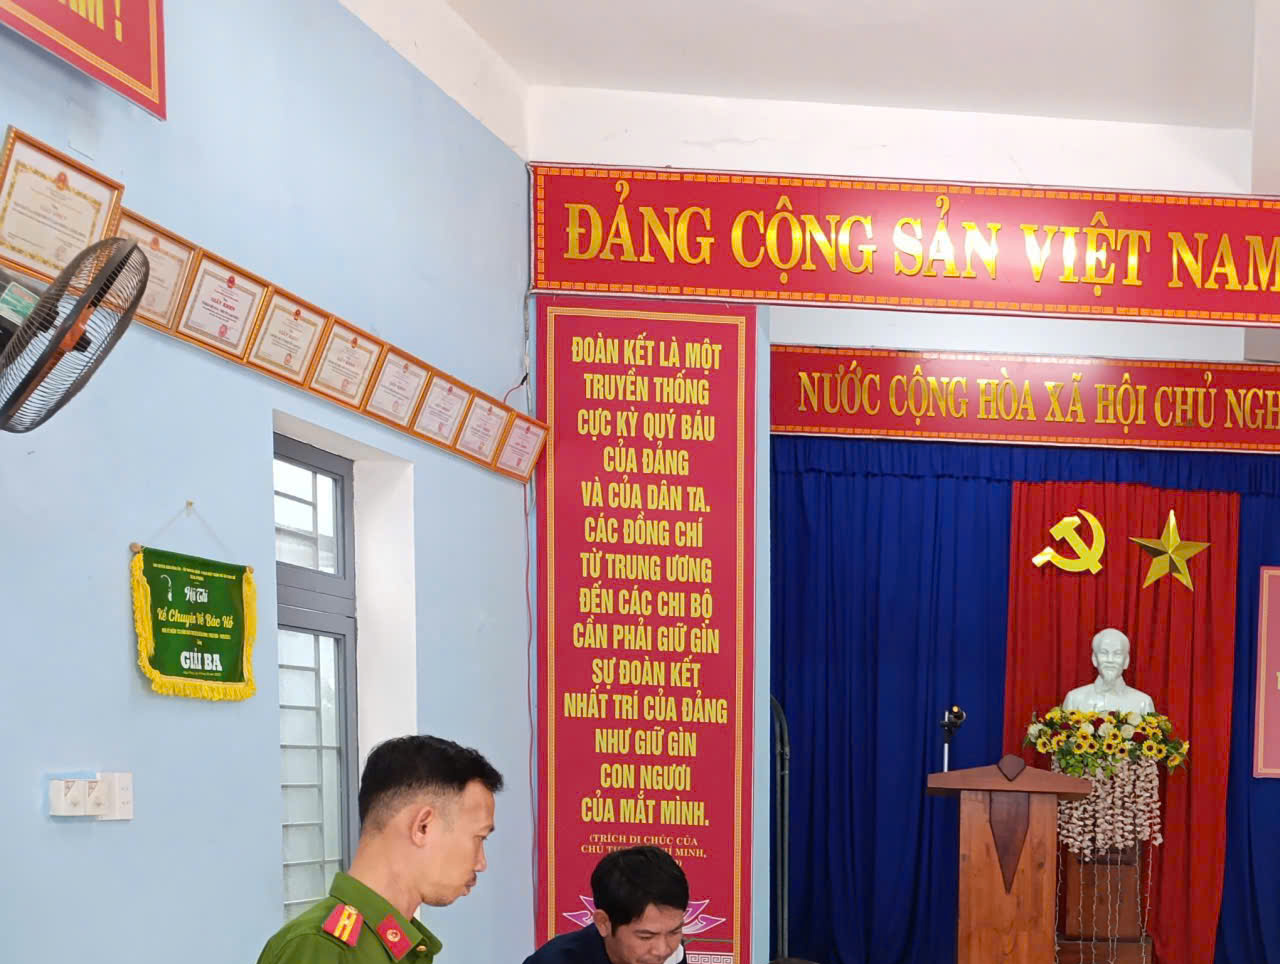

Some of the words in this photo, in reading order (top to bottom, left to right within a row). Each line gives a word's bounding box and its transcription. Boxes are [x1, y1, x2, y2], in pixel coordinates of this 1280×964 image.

[564, 180, 714, 265] ĐẢNG
[732, 195, 876, 286] CỘNG
[893, 195, 1001, 280] SẢN
[1020, 211, 1151, 297] VIỆT
[572, 332, 619, 364] ĐOÀN
[624, 332, 655, 365] KẾT
[659, 336, 681, 367] LÀ
[685, 338, 722, 375] MỘT
[584, 367, 648, 402] TRUYỀN
[653, 369, 710, 405] THỐNG
[798, 364, 881, 417] NƯỚC
[890, 367, 969, 428] CỘNG
[976, 367, 1040, 423] HÒA
[1045, 371, 1089, 424] XÃ
[1095, 375, 1148, 432] HỘI
[1155, 370, 1218, 430] CHỦ
[577, 408, 612, 441] CỰC
[616, 406, 639, 438] KỲ
[643, 408, 676, 442] QUÝ
[681, 410, 715, 441] BÁU
[580, 548, 603, 578] TỪ
[606, 553, 661, 582] TRUNG
[665, 556, 712, 583] ƯƠNG
[573, 614, 608, 649] CẦN
[613, 617, 652, 651] PHẢI
[657, 621, 687, 653] GIỮ
[690, 623, 720, 654] GÌN
[203, 653, 223, 671] BA
[591, 657, 616, 690] SỰ
[619, 656, 665, 687] ĐOÀN
[670, 655, 701, 688] KẾT
[563, 685, 608, 718] NHẤT
[612, 689, 639, 720] TRÍ
[643, 687, 677, 722] CỦA
[681, 690, 728, 724] ĐẢNG
[600, 763, 635, 789] CON
[639, 763, 691, 791] NGƯƠI
[581, 789, 615, 822] CỦA
[620, 790, 656, 824] MẮT
[660, 796, 710, 826] MÌNH.
[629, 835, 641, 844] DI
[676, 834, 698, 846] CỦA
